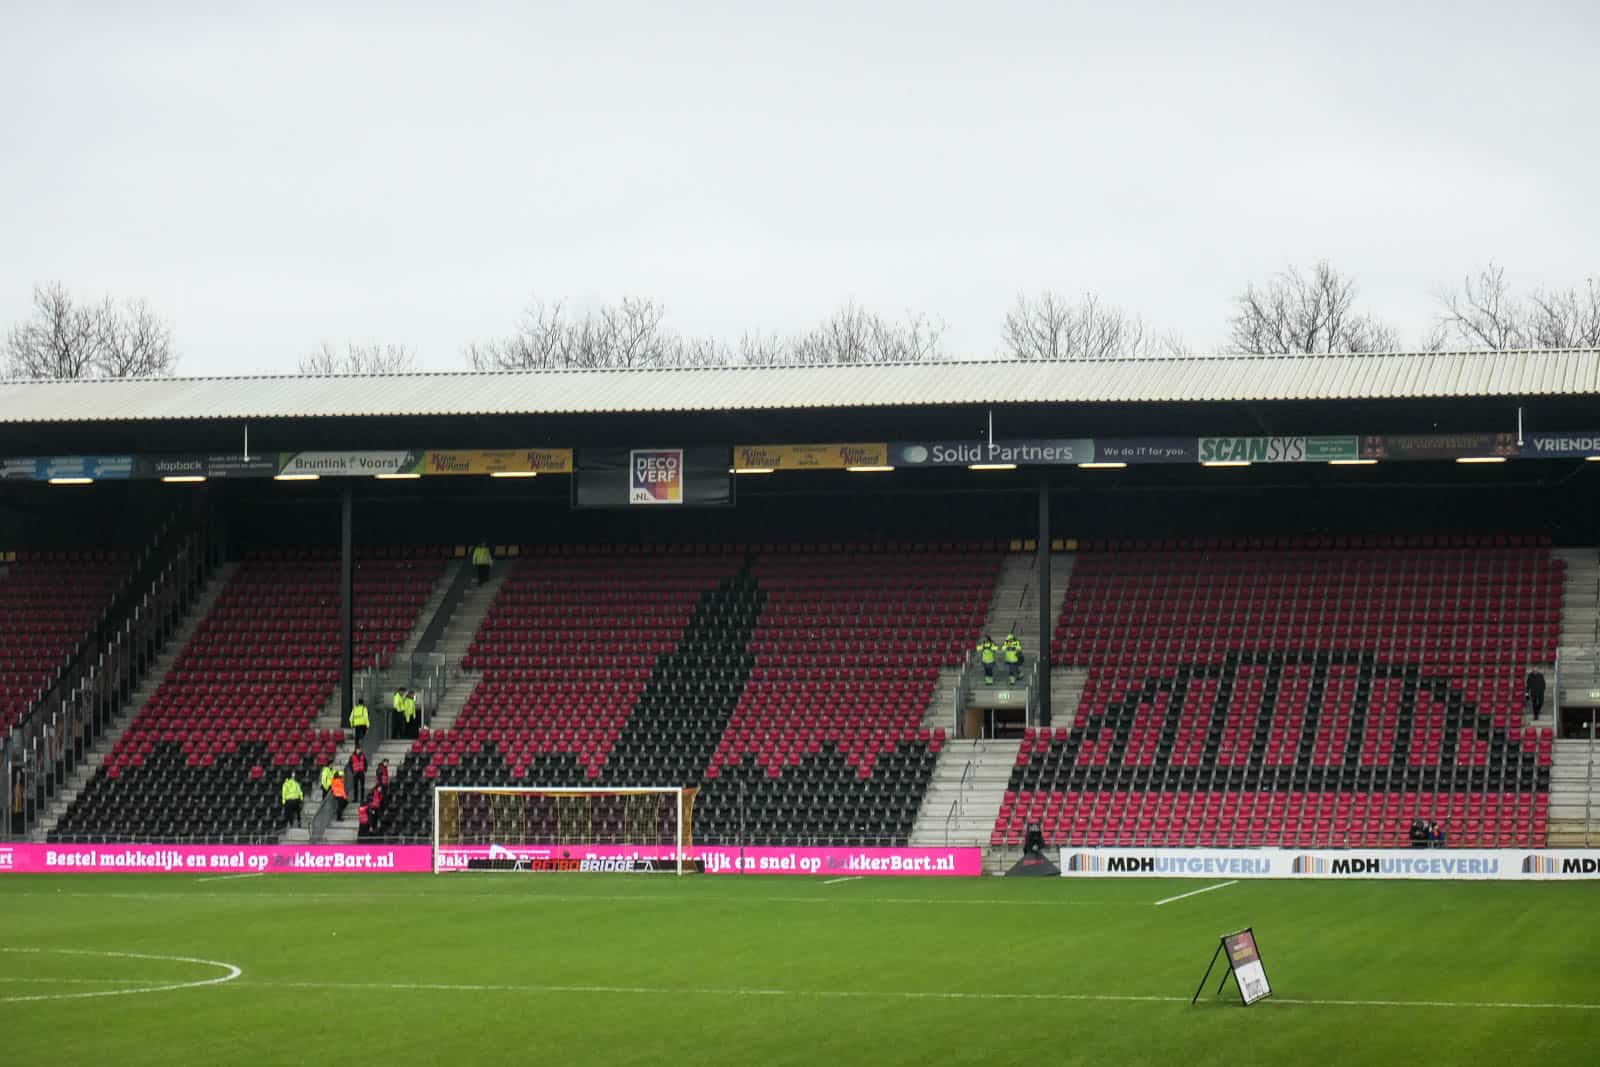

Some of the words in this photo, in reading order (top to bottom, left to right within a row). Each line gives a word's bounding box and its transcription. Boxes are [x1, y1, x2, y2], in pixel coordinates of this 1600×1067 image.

[1103, 447, 1119, 455] We
[1121, 447, 1135, 455] do
[1149, 446, 1163, 455] for
[1201, 438, 1304, 463] SCANSYS
[1533, 437, 1600, 452] VRIENDE
[932, 445, 981, 462] Solid
[989, 443, 1073, 463] Partners
[295, 457, 347, 469] Bruntink
[359, 457, 399, 469] Voorst
[637, 457, 678, 471] DECO
[637, 470, 676, 483] VERF
[45, 850, 96, 867] Bestel
[99, 850, 183, 871] makkelijk
[186, 854, 207, 867] en
[210, 851, 244, 867] snel
[247, 854, 269, 871] op
[759, 854, 796, 870] snel
[799, 857, 821, 873] op
[1107, 857, 1271, 873] MDHUITGEVERIJ
[1331, 858, 1499, 874] MDHUITGEVERIJ
[1562, 858, 1600, 873] MD
